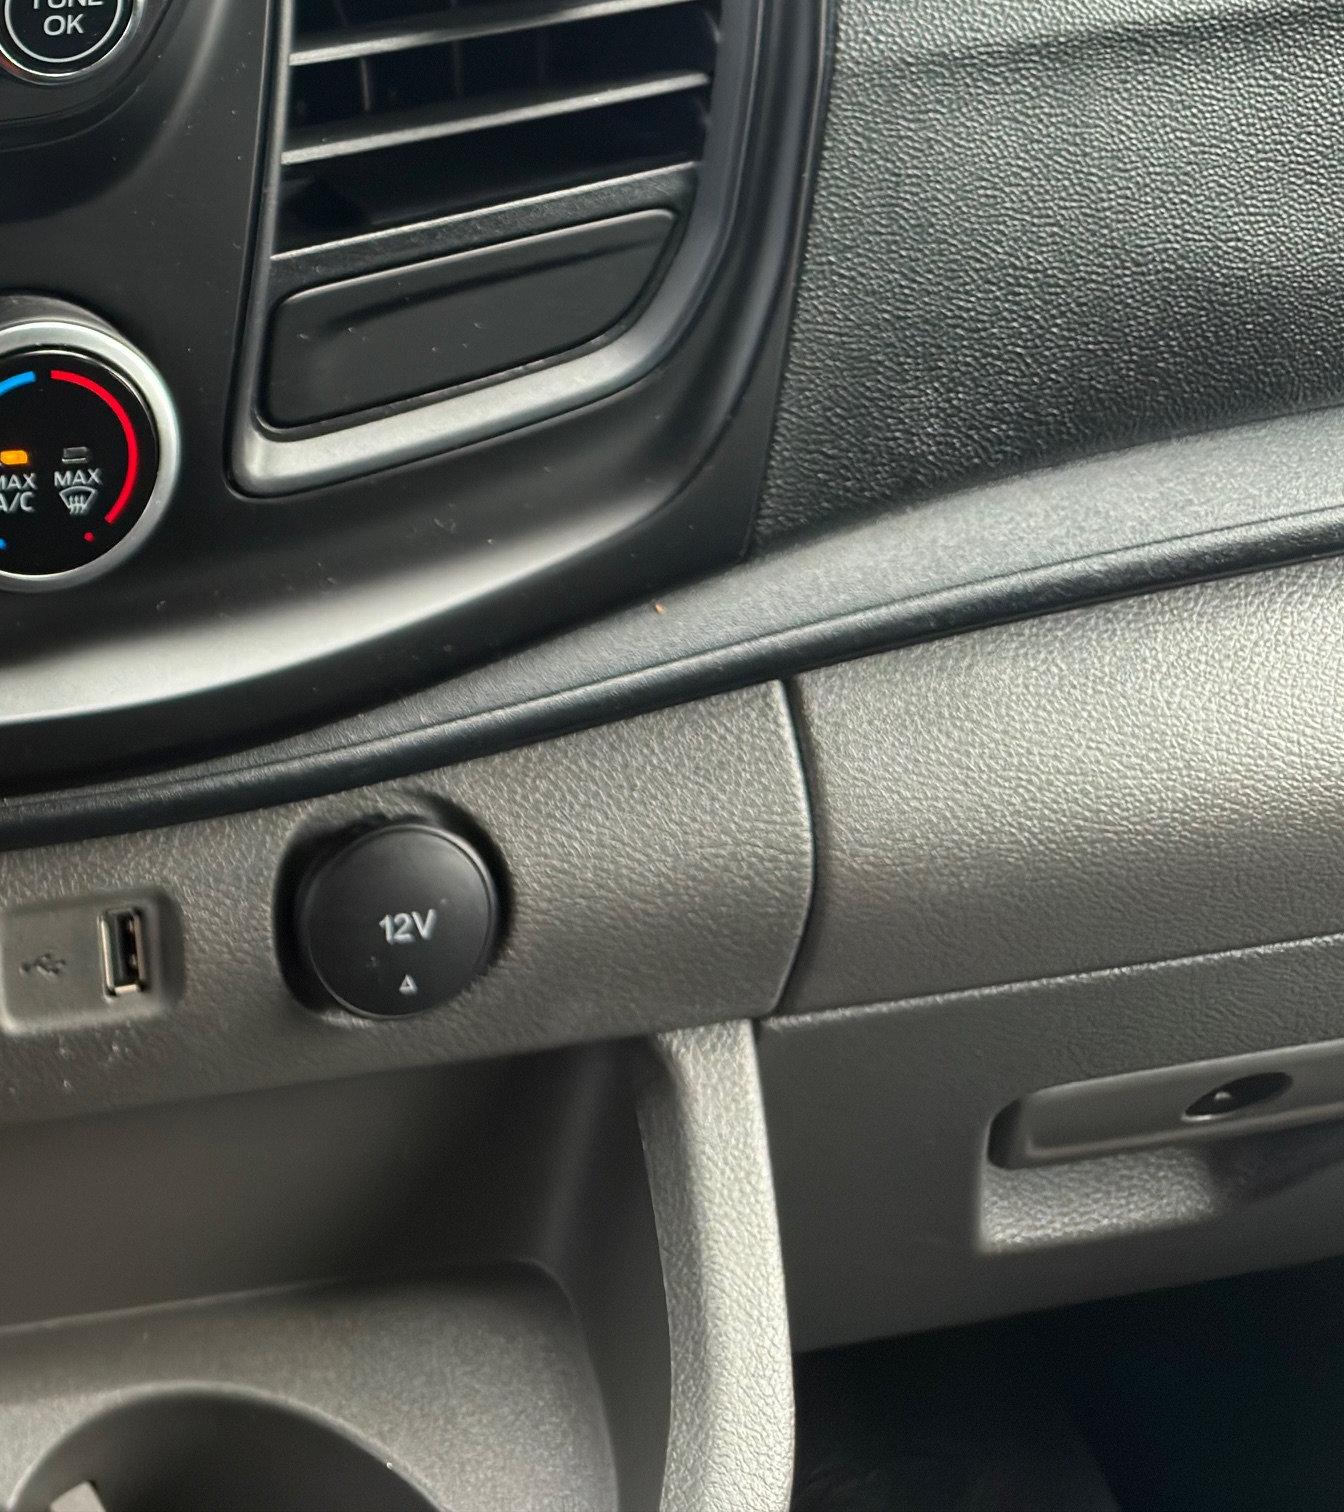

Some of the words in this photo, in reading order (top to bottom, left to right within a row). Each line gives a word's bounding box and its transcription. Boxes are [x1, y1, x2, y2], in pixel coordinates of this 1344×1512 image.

[43, 13, 84, 36] OK
[54, 468, 101, 487] MAX
[379, 908, 436, 943] 12V
